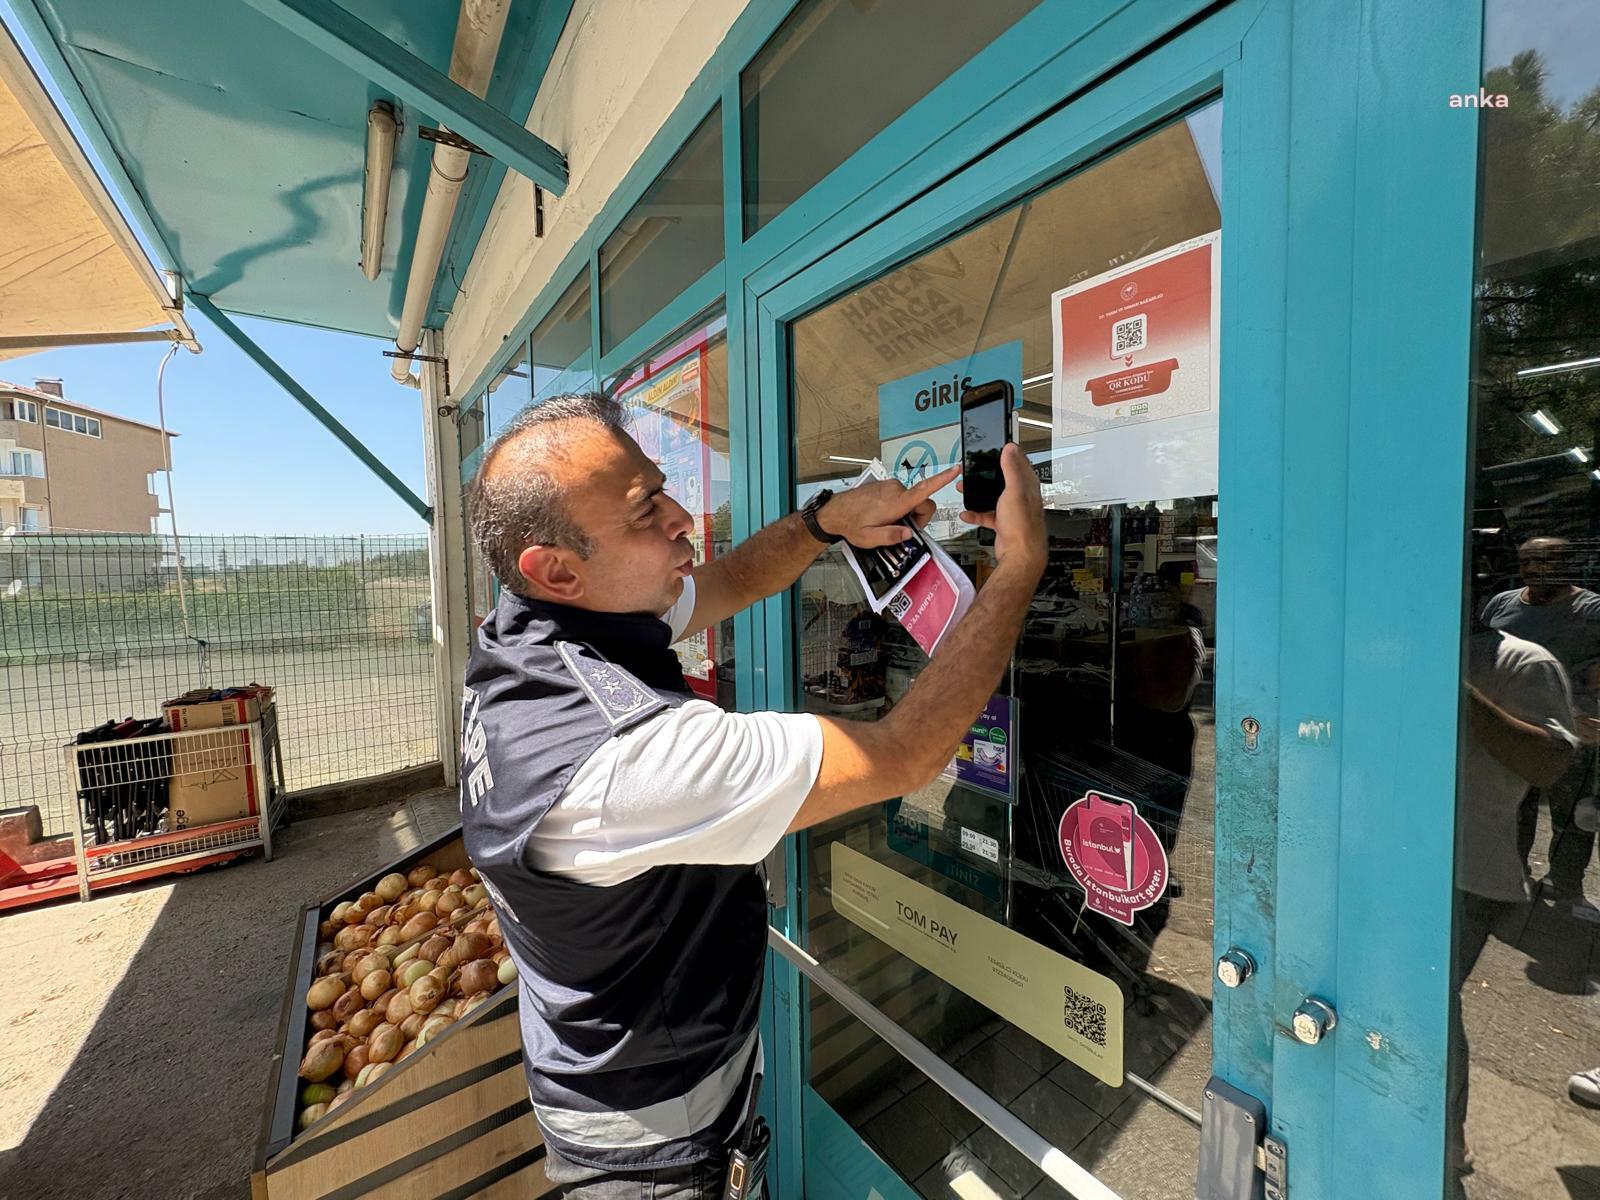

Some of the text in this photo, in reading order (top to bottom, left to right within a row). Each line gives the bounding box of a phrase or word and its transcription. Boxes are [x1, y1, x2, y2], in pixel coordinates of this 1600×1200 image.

[839, 266, 935, 325] HARCA
[857, 287, 951, 344] HARCA
[1109, 381, 1122, 391] QR
[1123, 374, 1151, 387] KODU
[1063, 838, 1083, 877] Burada
[895, 900, 927, 929] TOM
[930, 919, 958, 946] PAY
